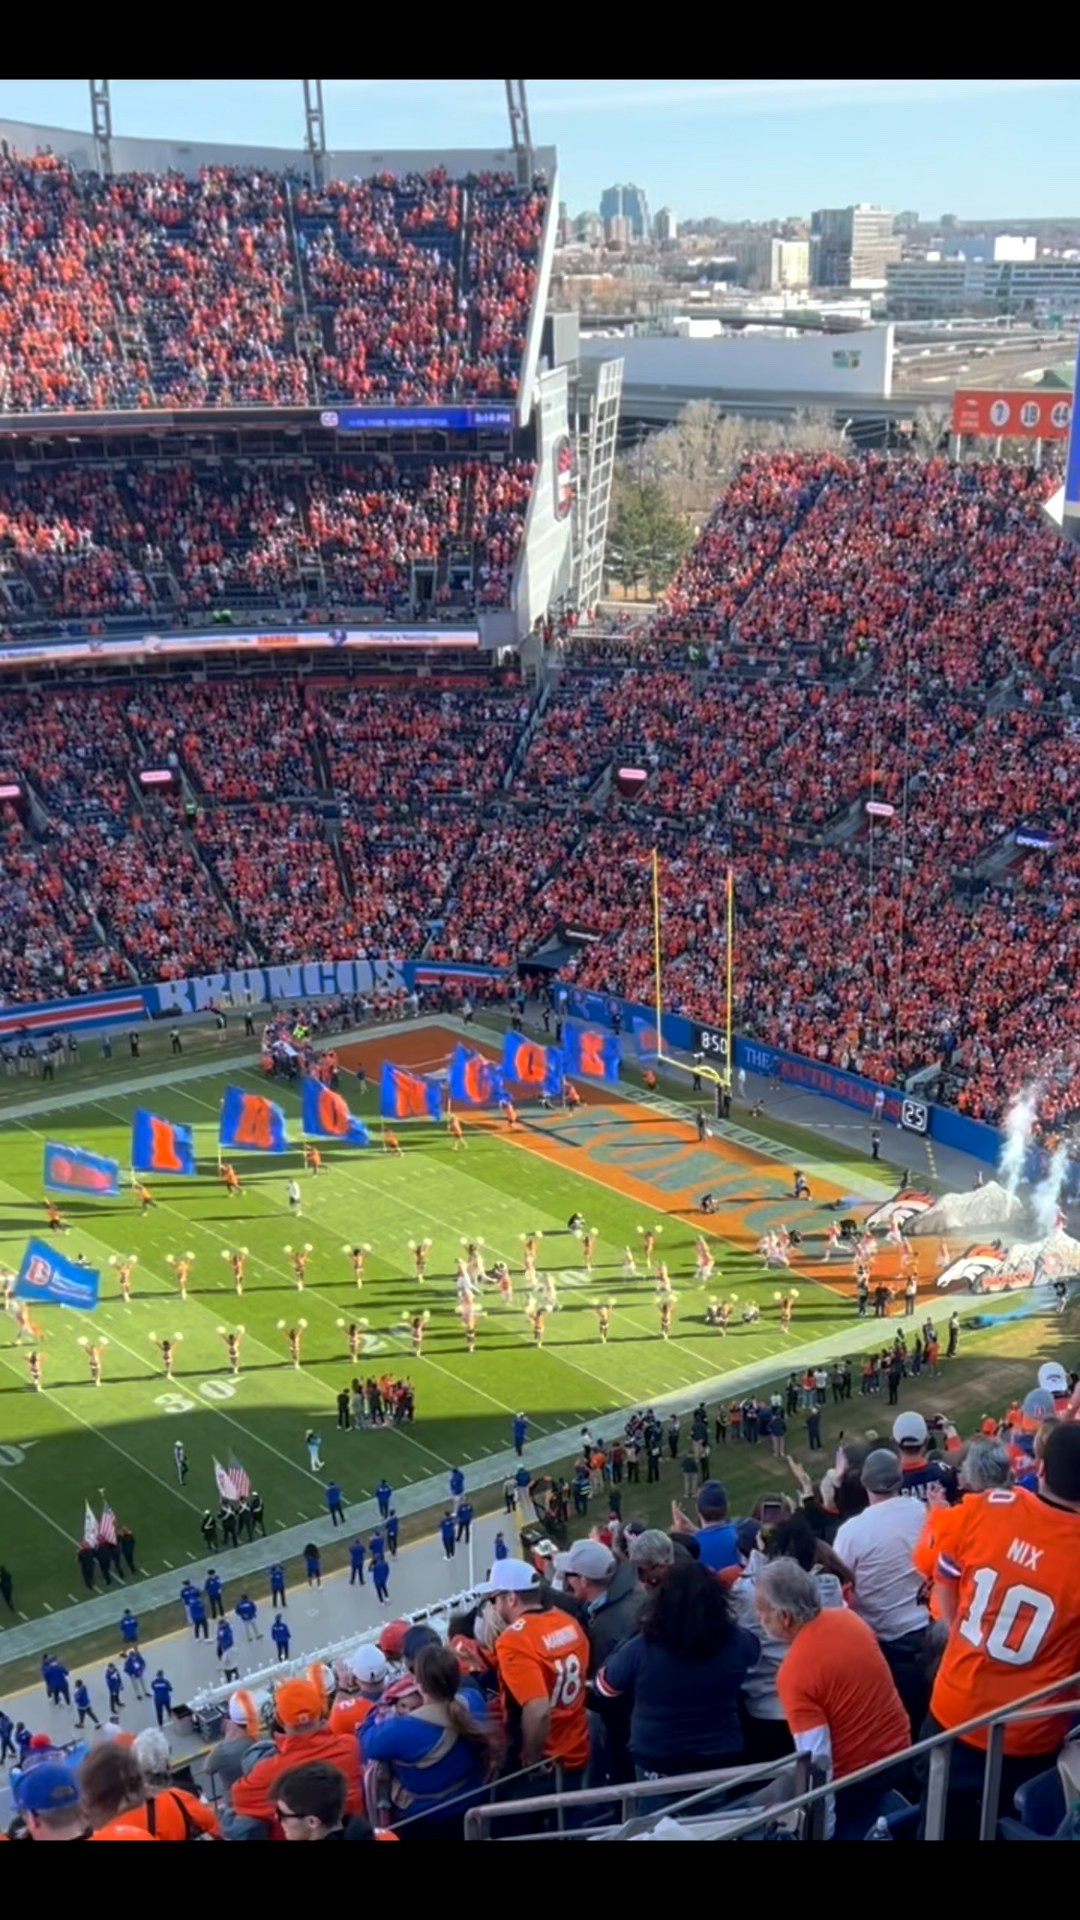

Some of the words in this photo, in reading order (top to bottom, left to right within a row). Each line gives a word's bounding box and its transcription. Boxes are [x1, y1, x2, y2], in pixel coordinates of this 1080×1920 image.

[157, 960, 407, 1014] BRONCOS
[744, 1047, 770, 1069] THE
[778, 1058, 832, 1090] OUTH
[835, 1077, 901, 1118] STANS
[905, 1104, 925, 1127] 25
[723, 1128, 796, 1157] LOVE
[154, 1379, 236, 1414] 30
[1007, 1537, 1045, 1571] NIX
[960, 1567, 1056, 1666] 10
[550, 1653, 581, 1709] 18
